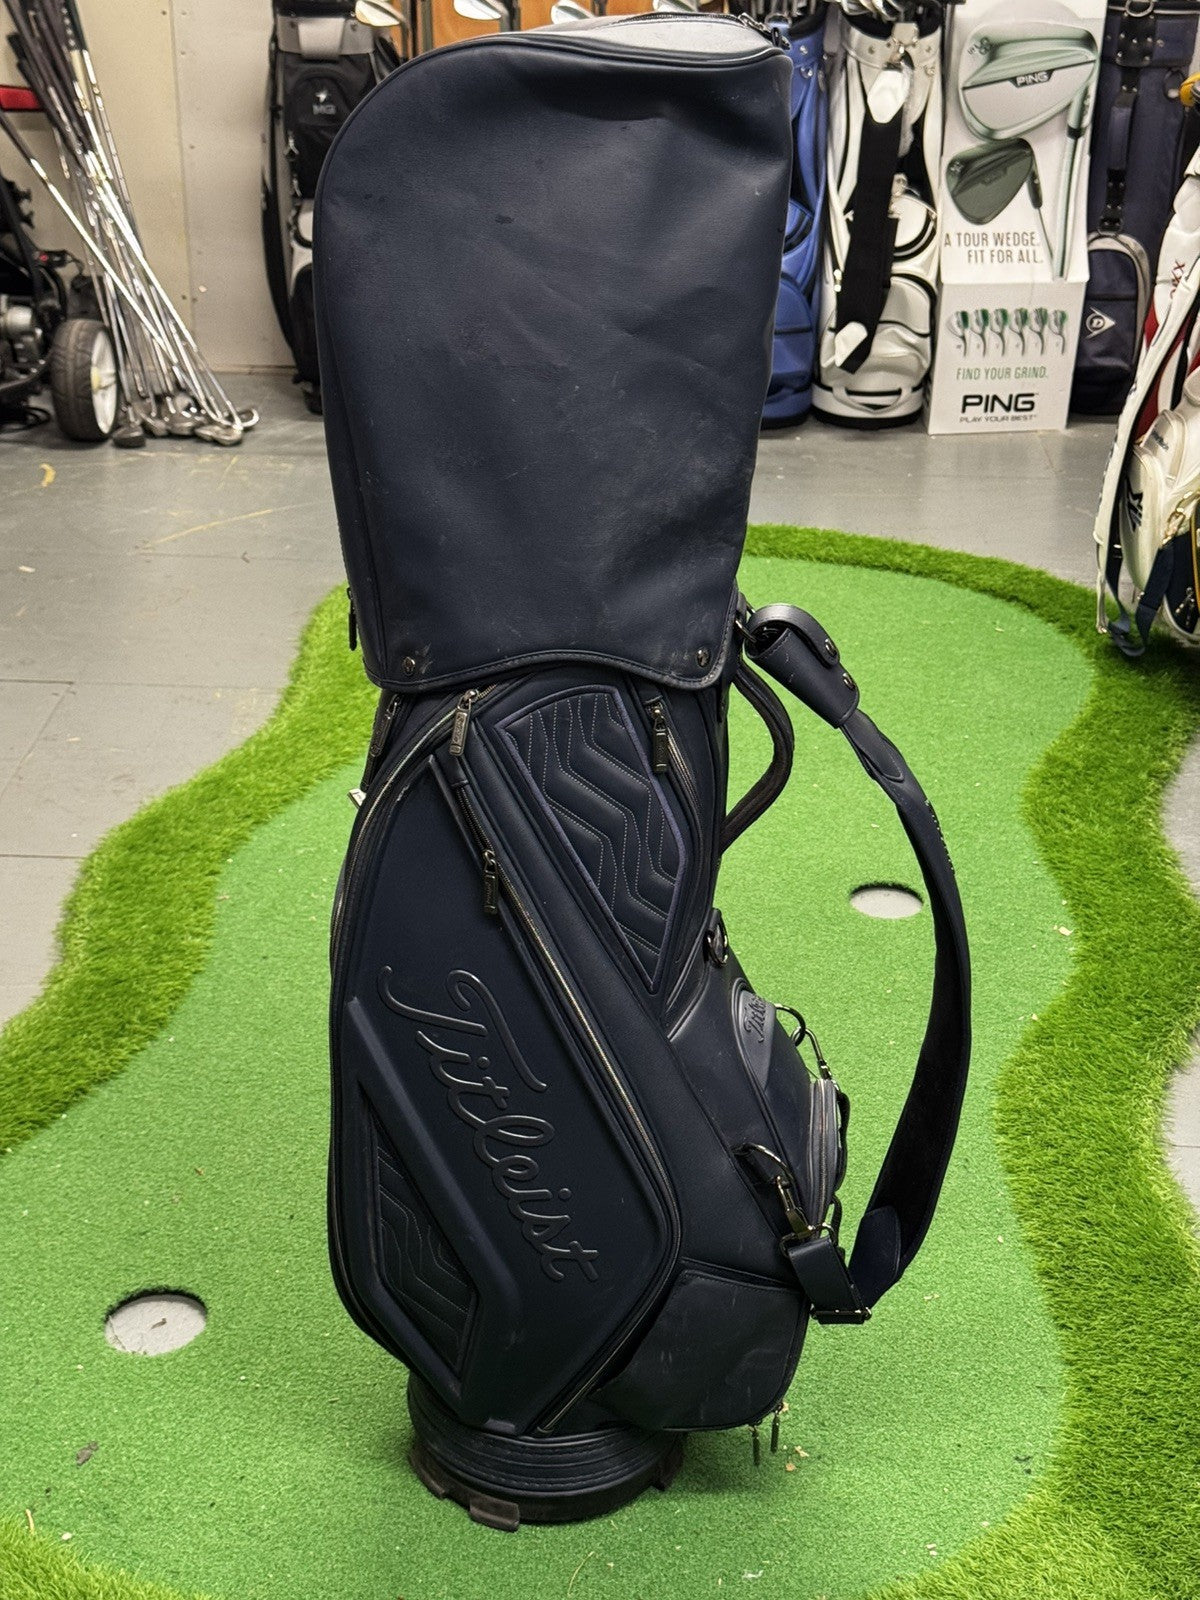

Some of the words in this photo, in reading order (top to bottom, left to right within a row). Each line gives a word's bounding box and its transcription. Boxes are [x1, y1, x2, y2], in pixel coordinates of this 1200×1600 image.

[1015, 71, 1050, 86] PING
[944, 232, 952, 247] A
[957, 232, 989, 247] TOUR
[967, 250, 985, 264] FIT
[990, 250, 1013, 264] FOR
[1018, 249, 1043, 264] ALL.
[956, 367, 981, 380] FIND
[984, 366, 1012, 380] YOUR
[1014, 365, 1048, 380] GRIND.
[961, 392, 1036, 414] PING
[960, 415, 983, 423] PLAY
[984, 414, 1010, 423] YOUR
[377, 964, 602, 1284] Titleist
